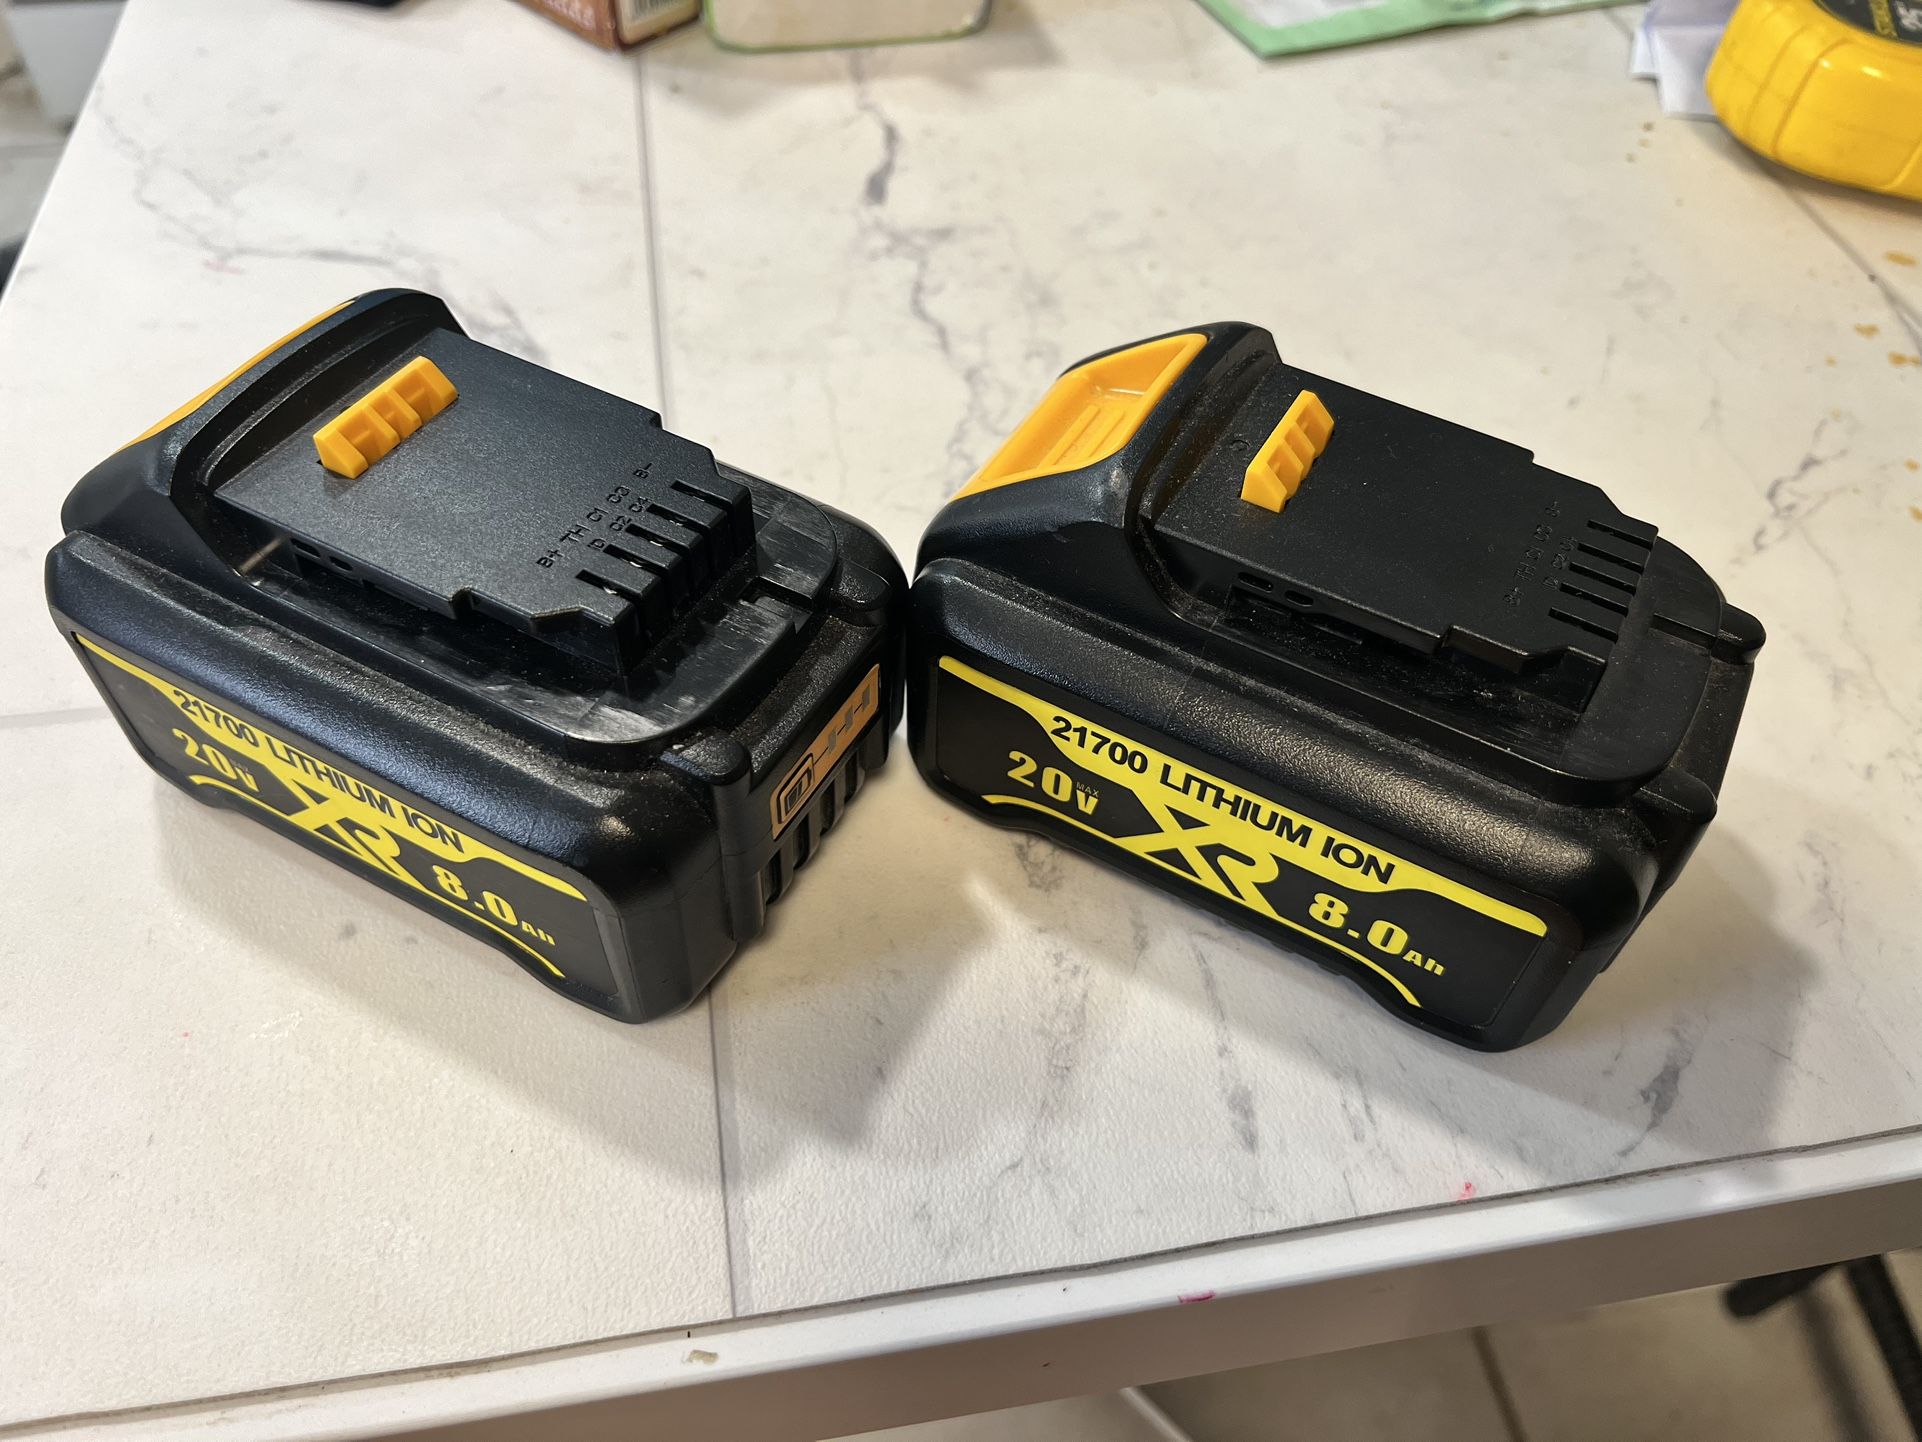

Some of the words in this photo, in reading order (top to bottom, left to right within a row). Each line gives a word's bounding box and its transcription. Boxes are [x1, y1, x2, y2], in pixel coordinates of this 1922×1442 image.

[560, 523, 592, 543] TH
[586, 507, 609, 523] C1
[606, 485, 632, 504] C3
[173, 689, 260, 748] 21700
[264, 735, 397, 819] LITHIUM
[401, 805, 465, 854] ION
[268, 765, 426, 892] XR
[1007, 750, 1099, 815] 20V
[1050, 714, 1148, 774] 21700
[1160, 762, 1312, 850] LITHIUM
[1320, 834, 1396, 885] ION
[1076, 781, 1100, 797] MAX
[1115, 788, 1282, 920] XR
